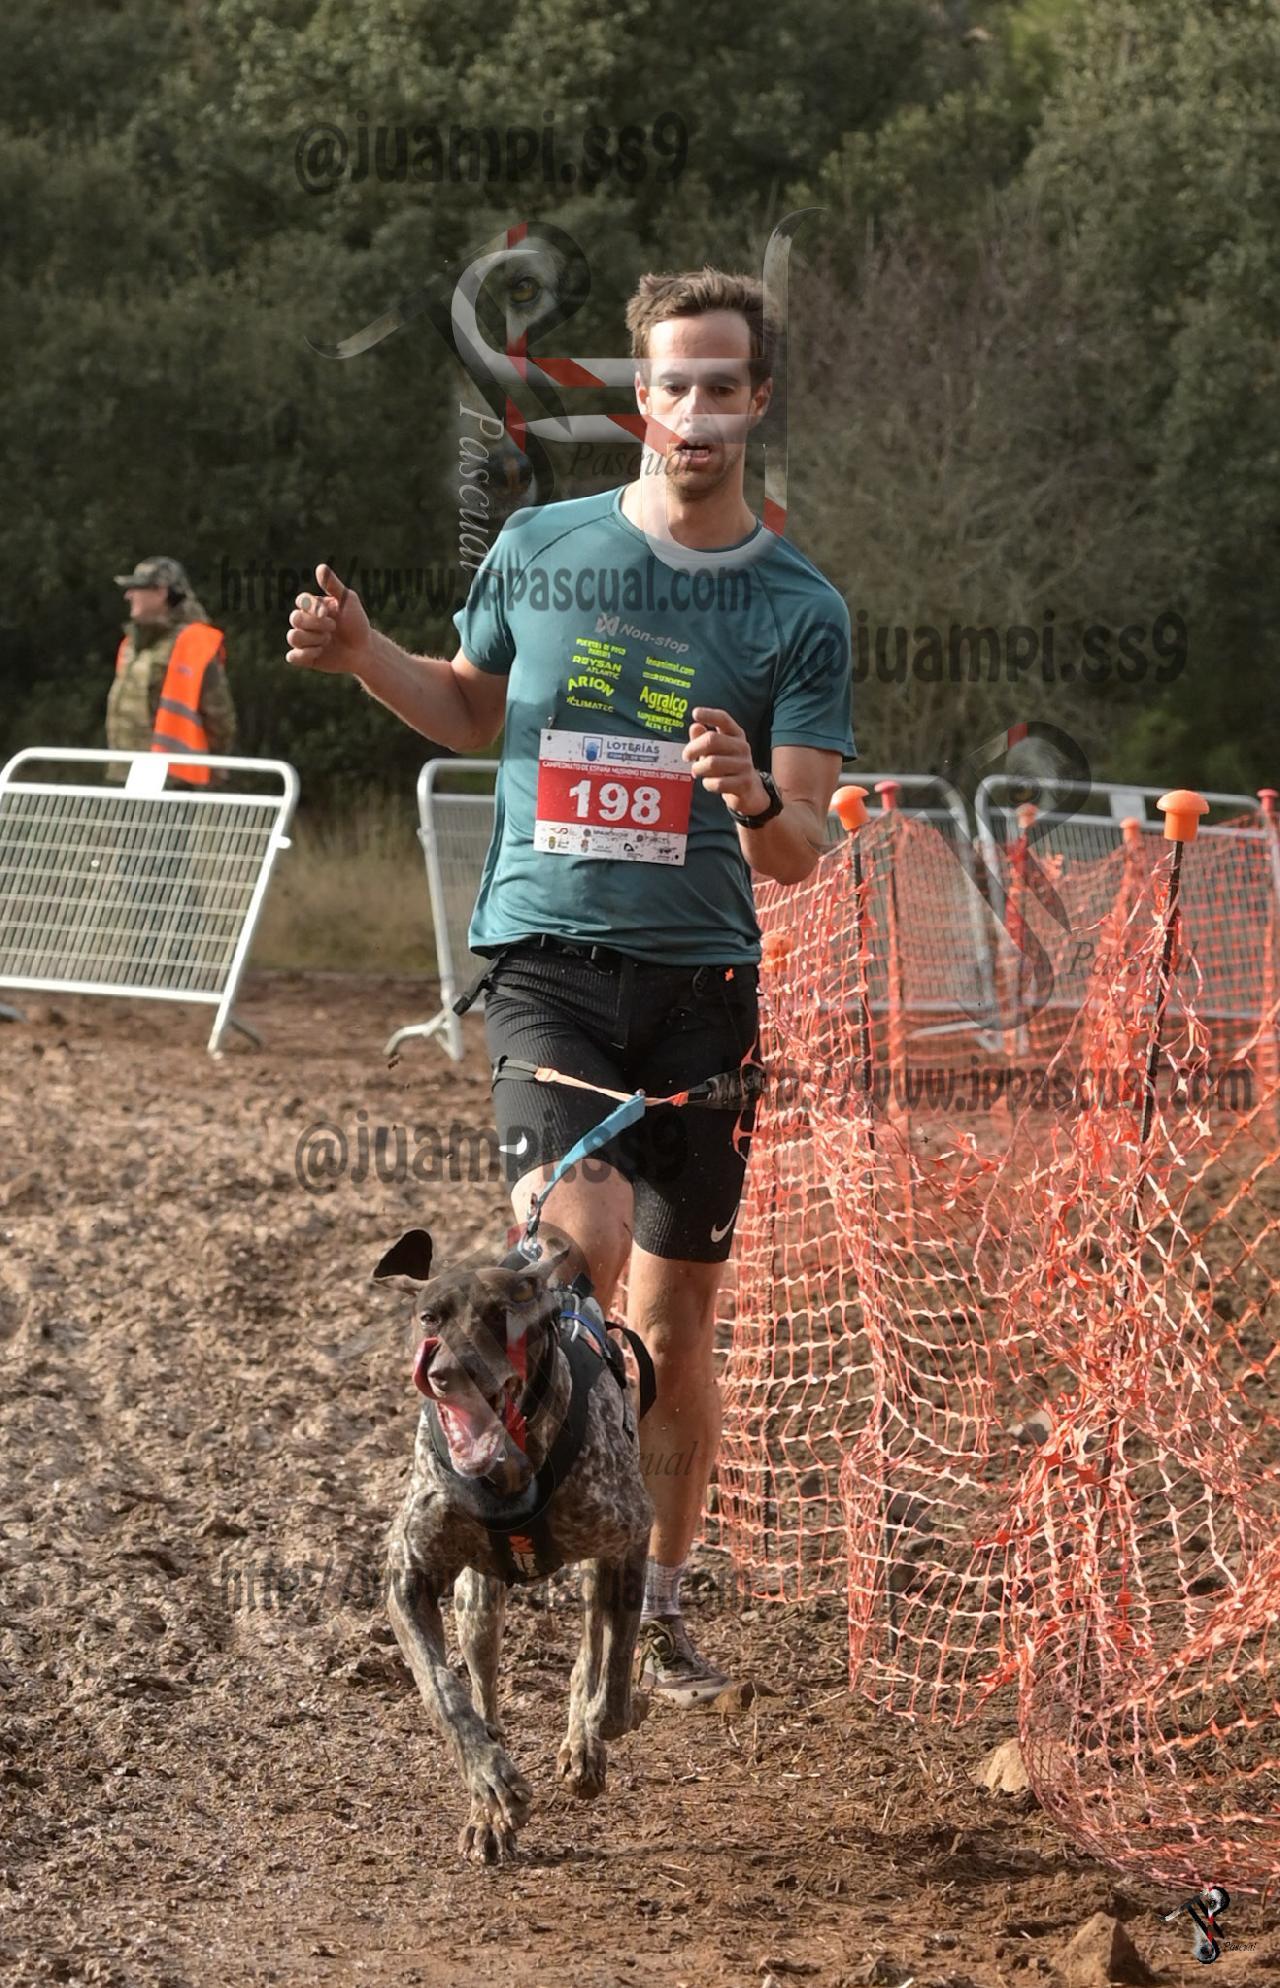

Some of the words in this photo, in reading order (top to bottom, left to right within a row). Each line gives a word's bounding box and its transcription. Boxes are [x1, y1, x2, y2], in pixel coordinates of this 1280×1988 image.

[619, 623, 689, 654] Non-stop
[567, 675, 615, 697] ARION
[639, 685, 689, 713] Agralco
[568, 779, 662, 826] 198
